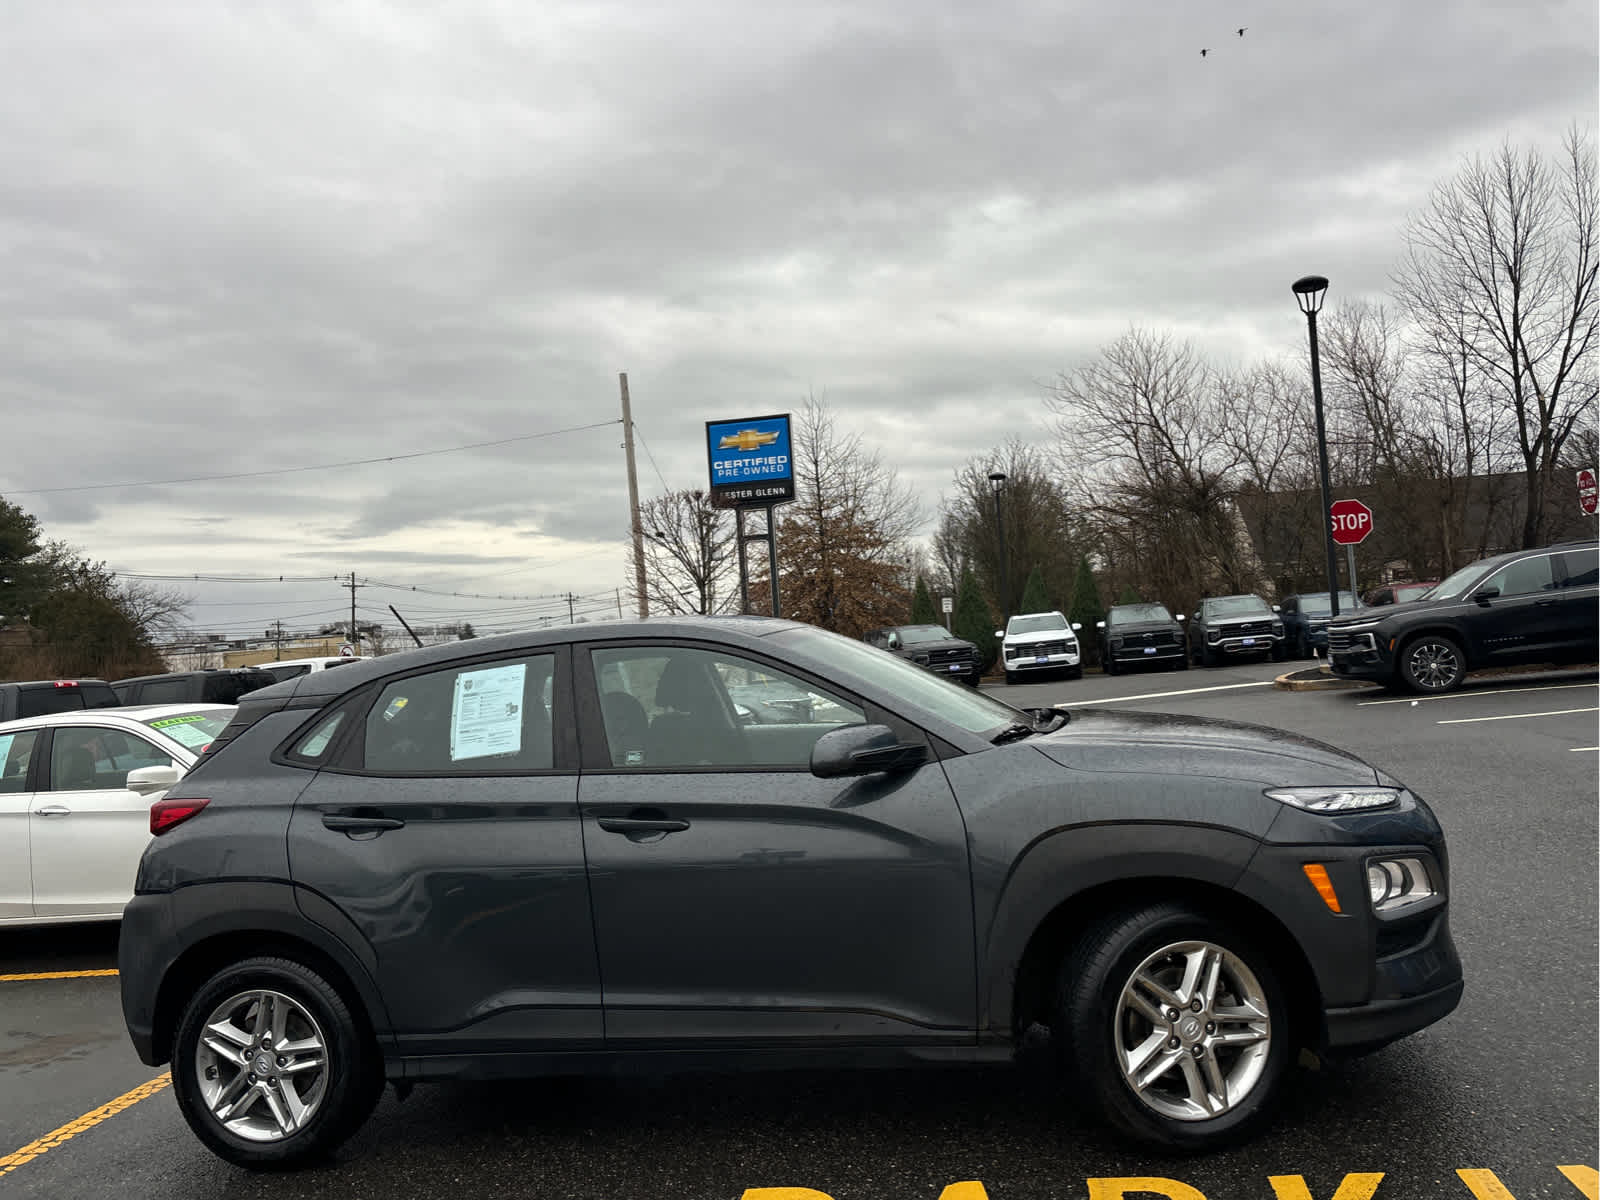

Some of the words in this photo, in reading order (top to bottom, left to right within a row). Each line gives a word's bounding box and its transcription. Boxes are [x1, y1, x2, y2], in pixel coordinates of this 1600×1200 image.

[713, 455, 788, 470] CERTIFIED
[717, 464, 784, 477] PRE-OWNED
[755, 487, 785, 497] GLENN
[1331, 512, 1369, 532] STOP
